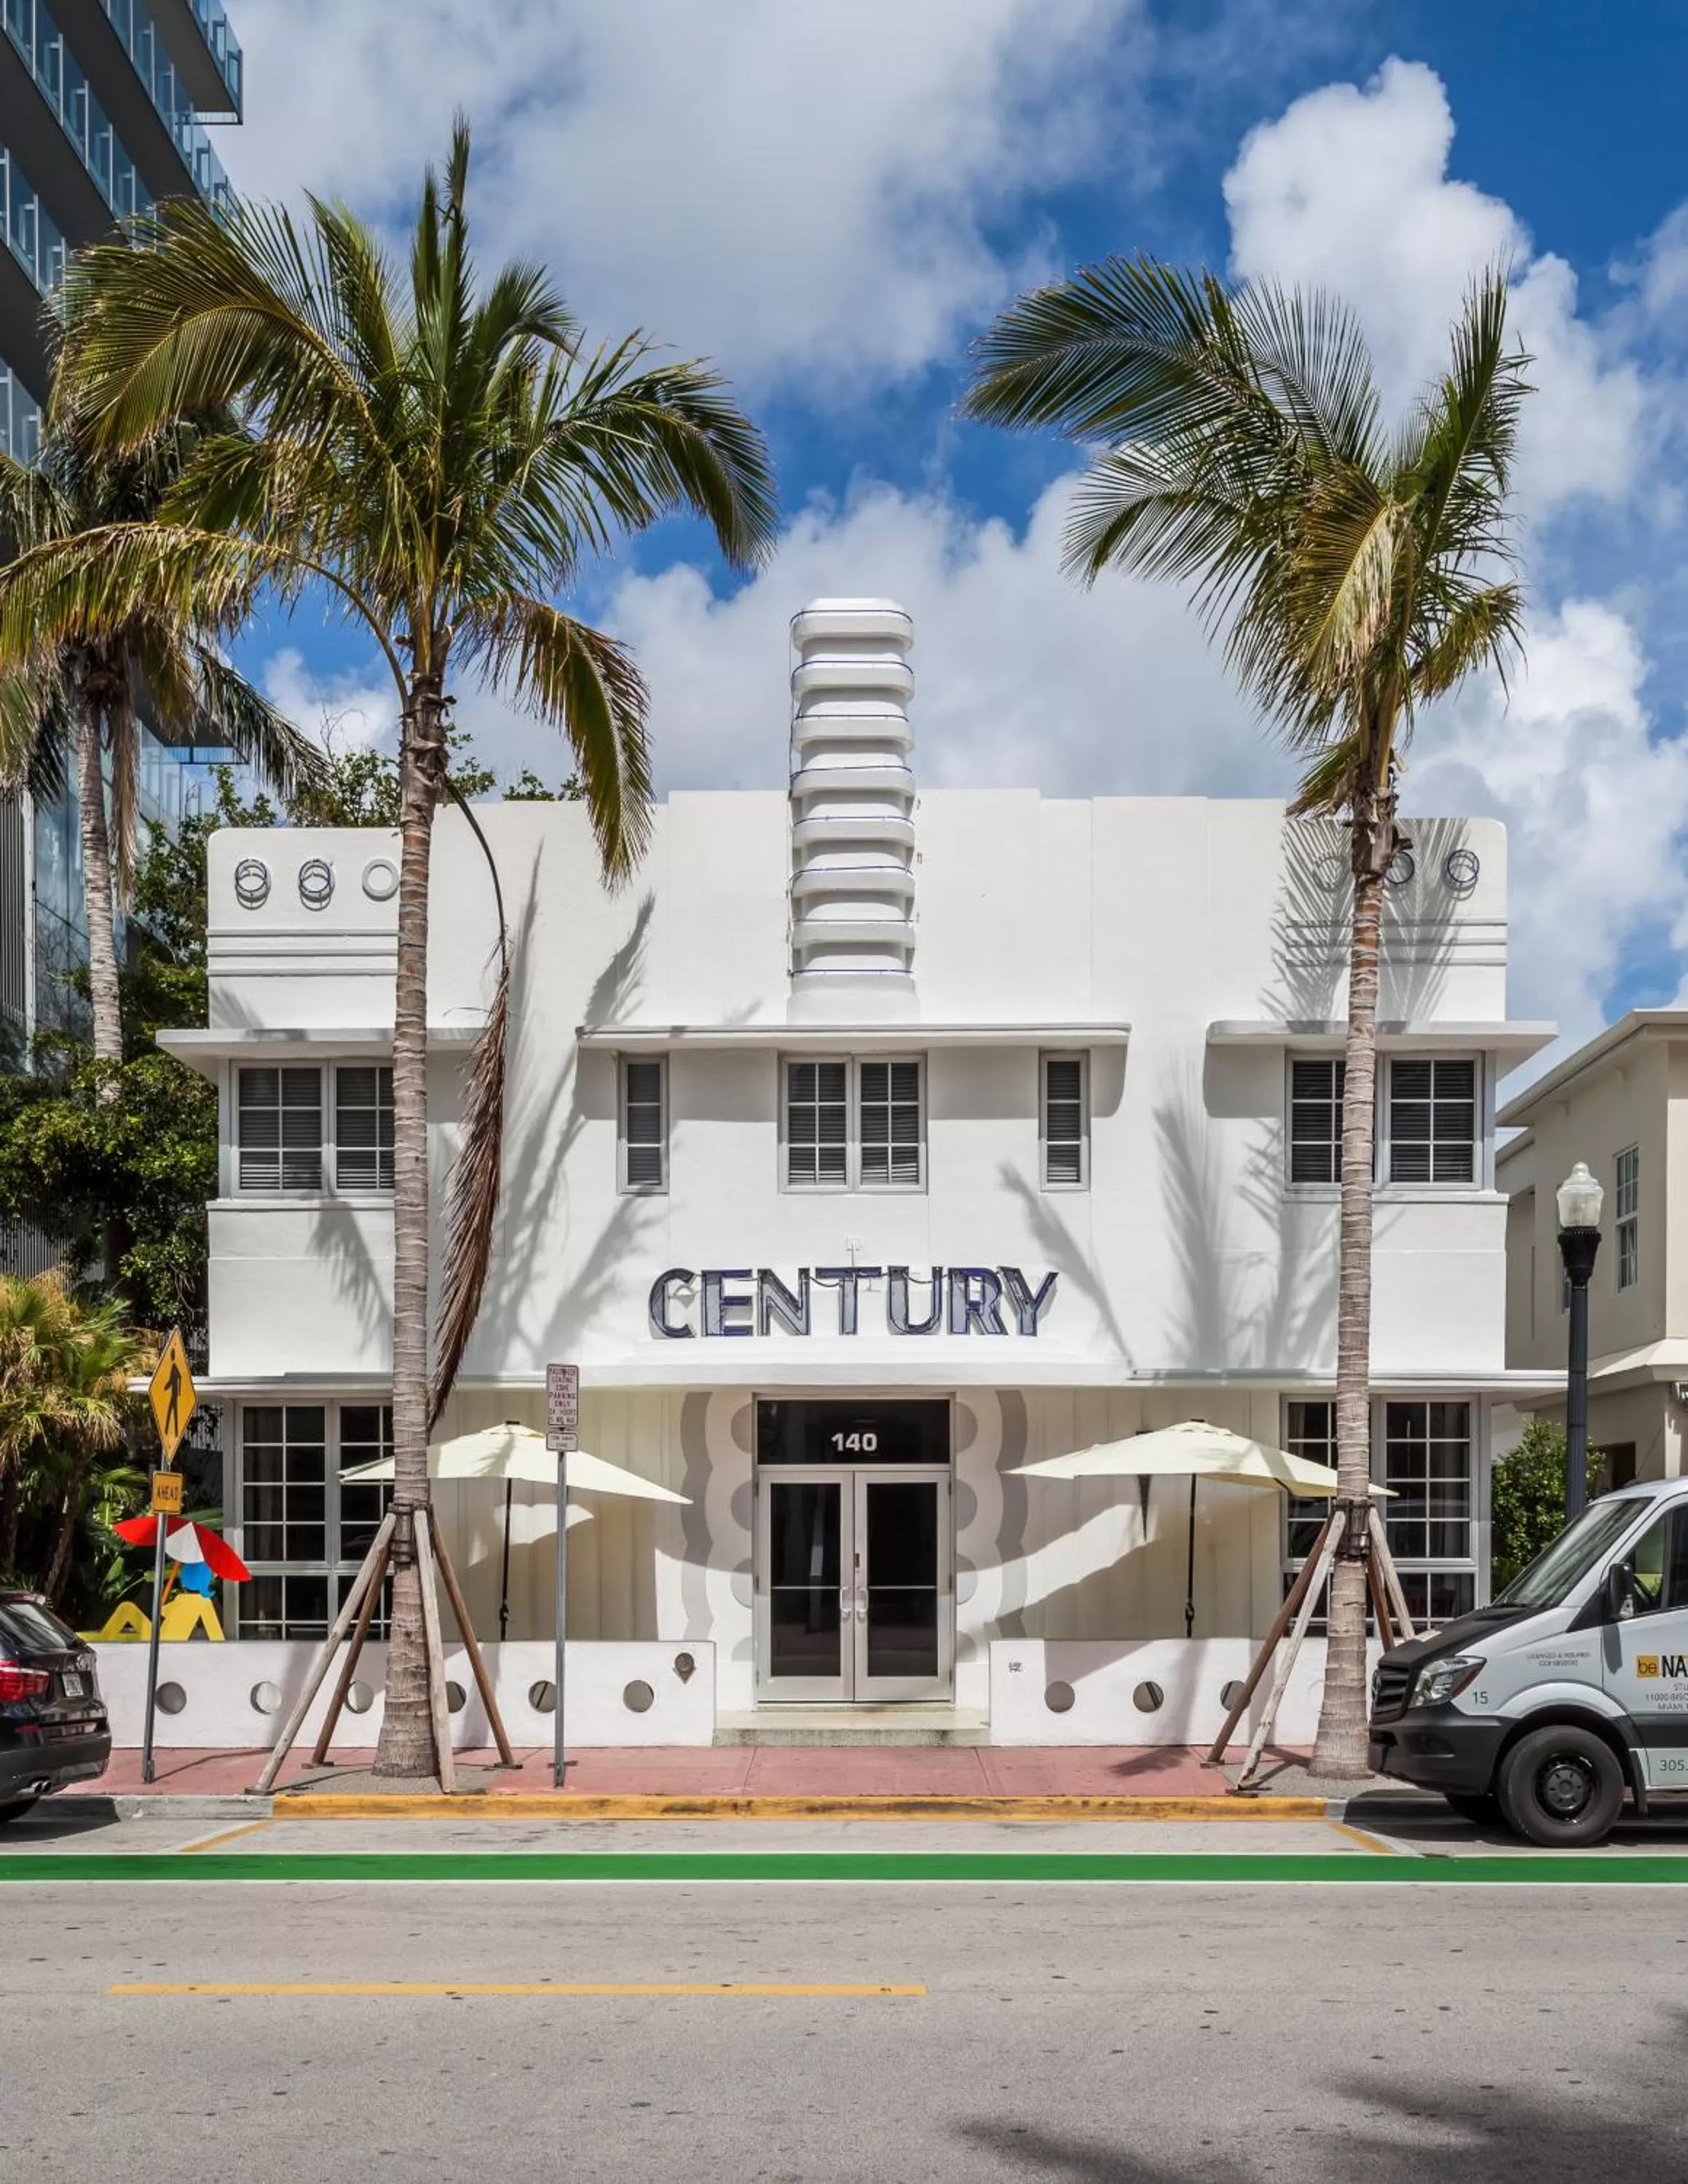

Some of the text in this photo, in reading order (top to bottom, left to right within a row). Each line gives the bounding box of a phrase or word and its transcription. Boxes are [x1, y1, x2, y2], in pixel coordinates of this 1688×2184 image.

[649, 1265, 1059, 1338] CENTURY
[832, 1433, 877, 1451] 140
[157, 1485, 179, 1500] AHEAD
[1472, 1690, 1488, 1704] 15
